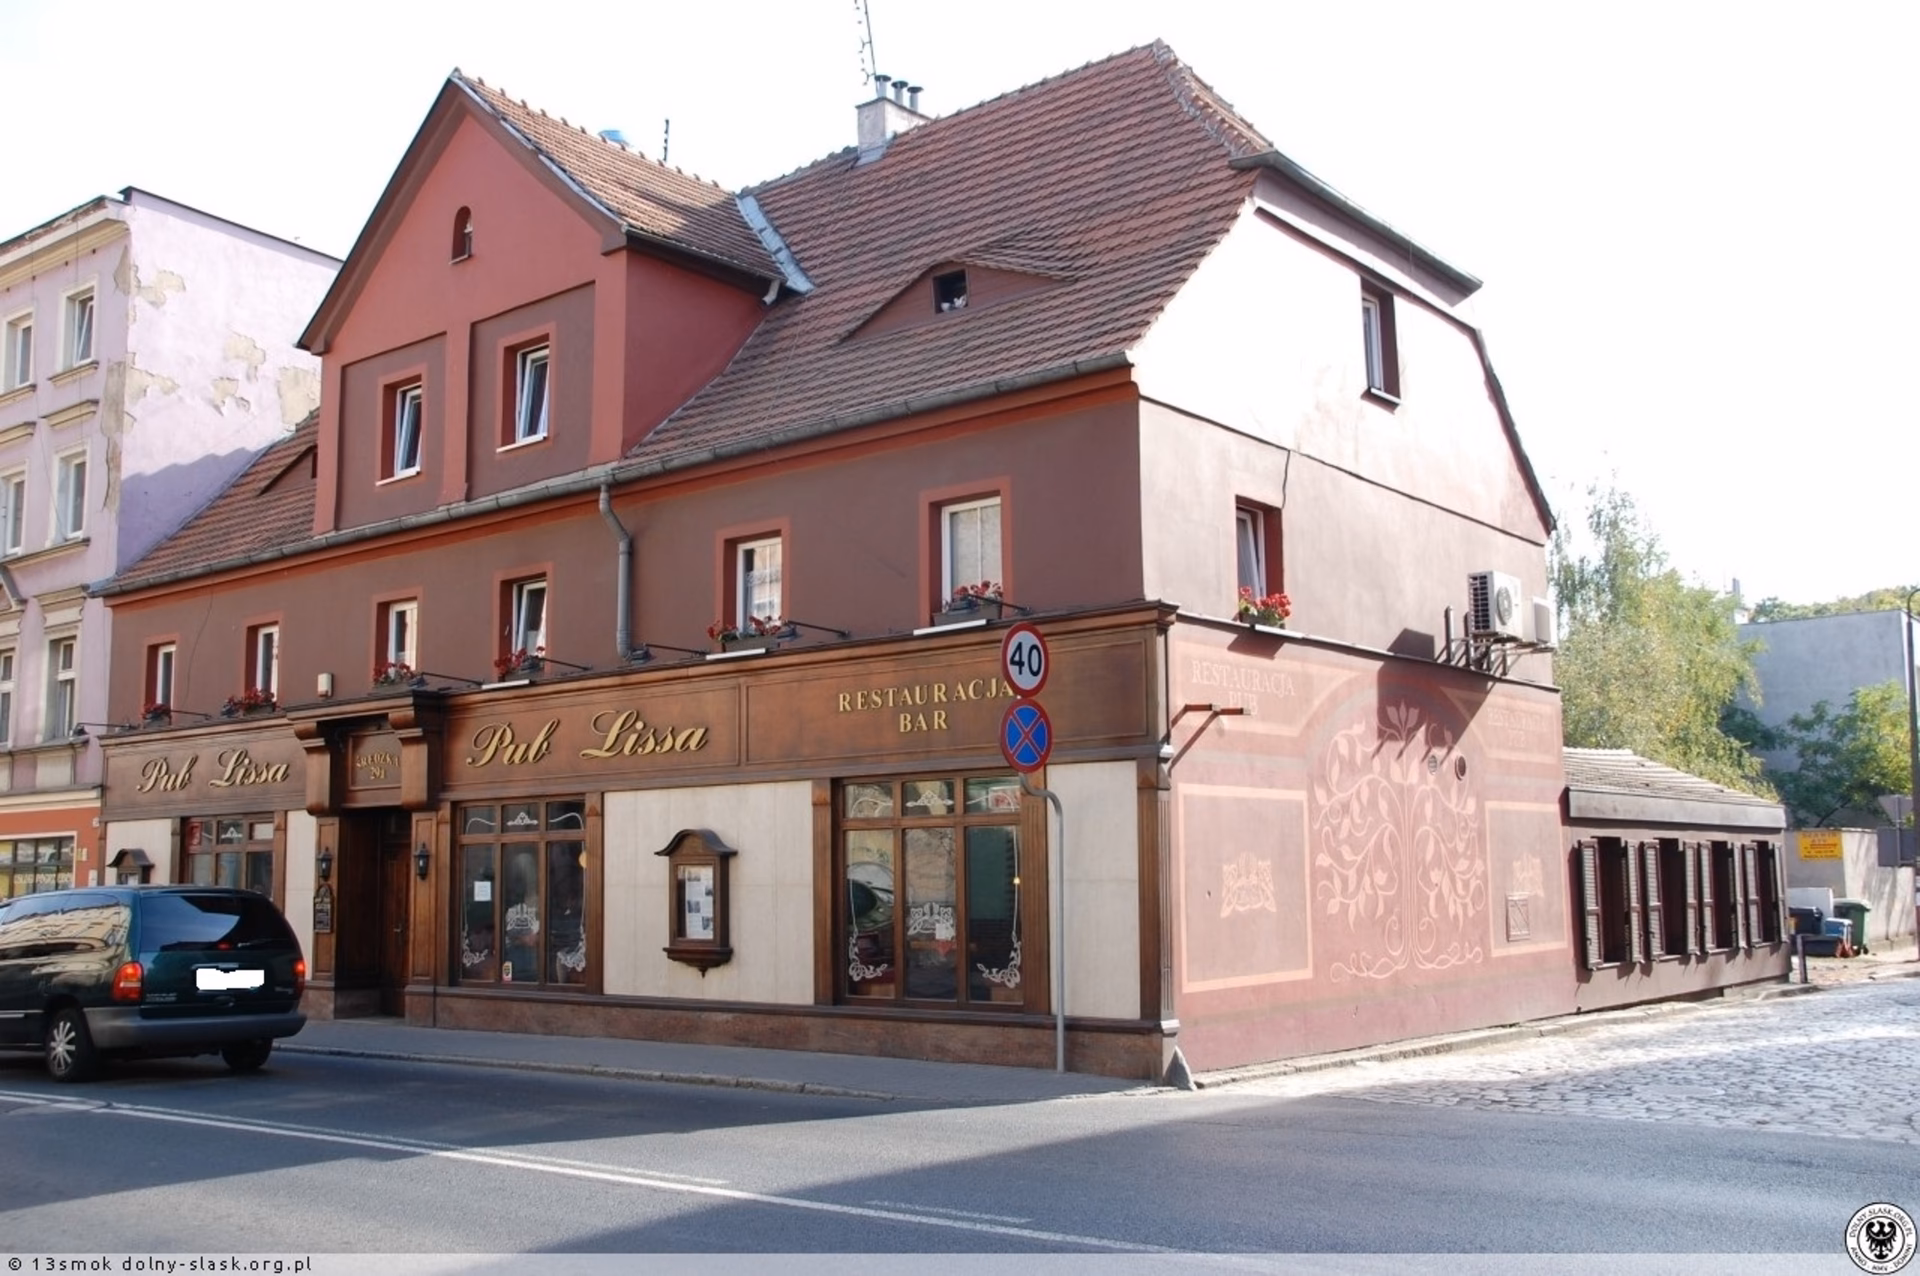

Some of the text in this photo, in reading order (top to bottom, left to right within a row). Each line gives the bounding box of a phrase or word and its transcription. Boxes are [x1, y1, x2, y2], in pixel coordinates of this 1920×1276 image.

[1009, 641, 1043, 677] 40
[838, 677, 1014, 712] RESTAURACJA
[1191, 660, 1297, 698] RESTAURACJA
[465, 709, 709, 768] Pub Lissa
[899, 710, 949, 733] BAR
[136, 749, 290, 794] Pub Lissa
